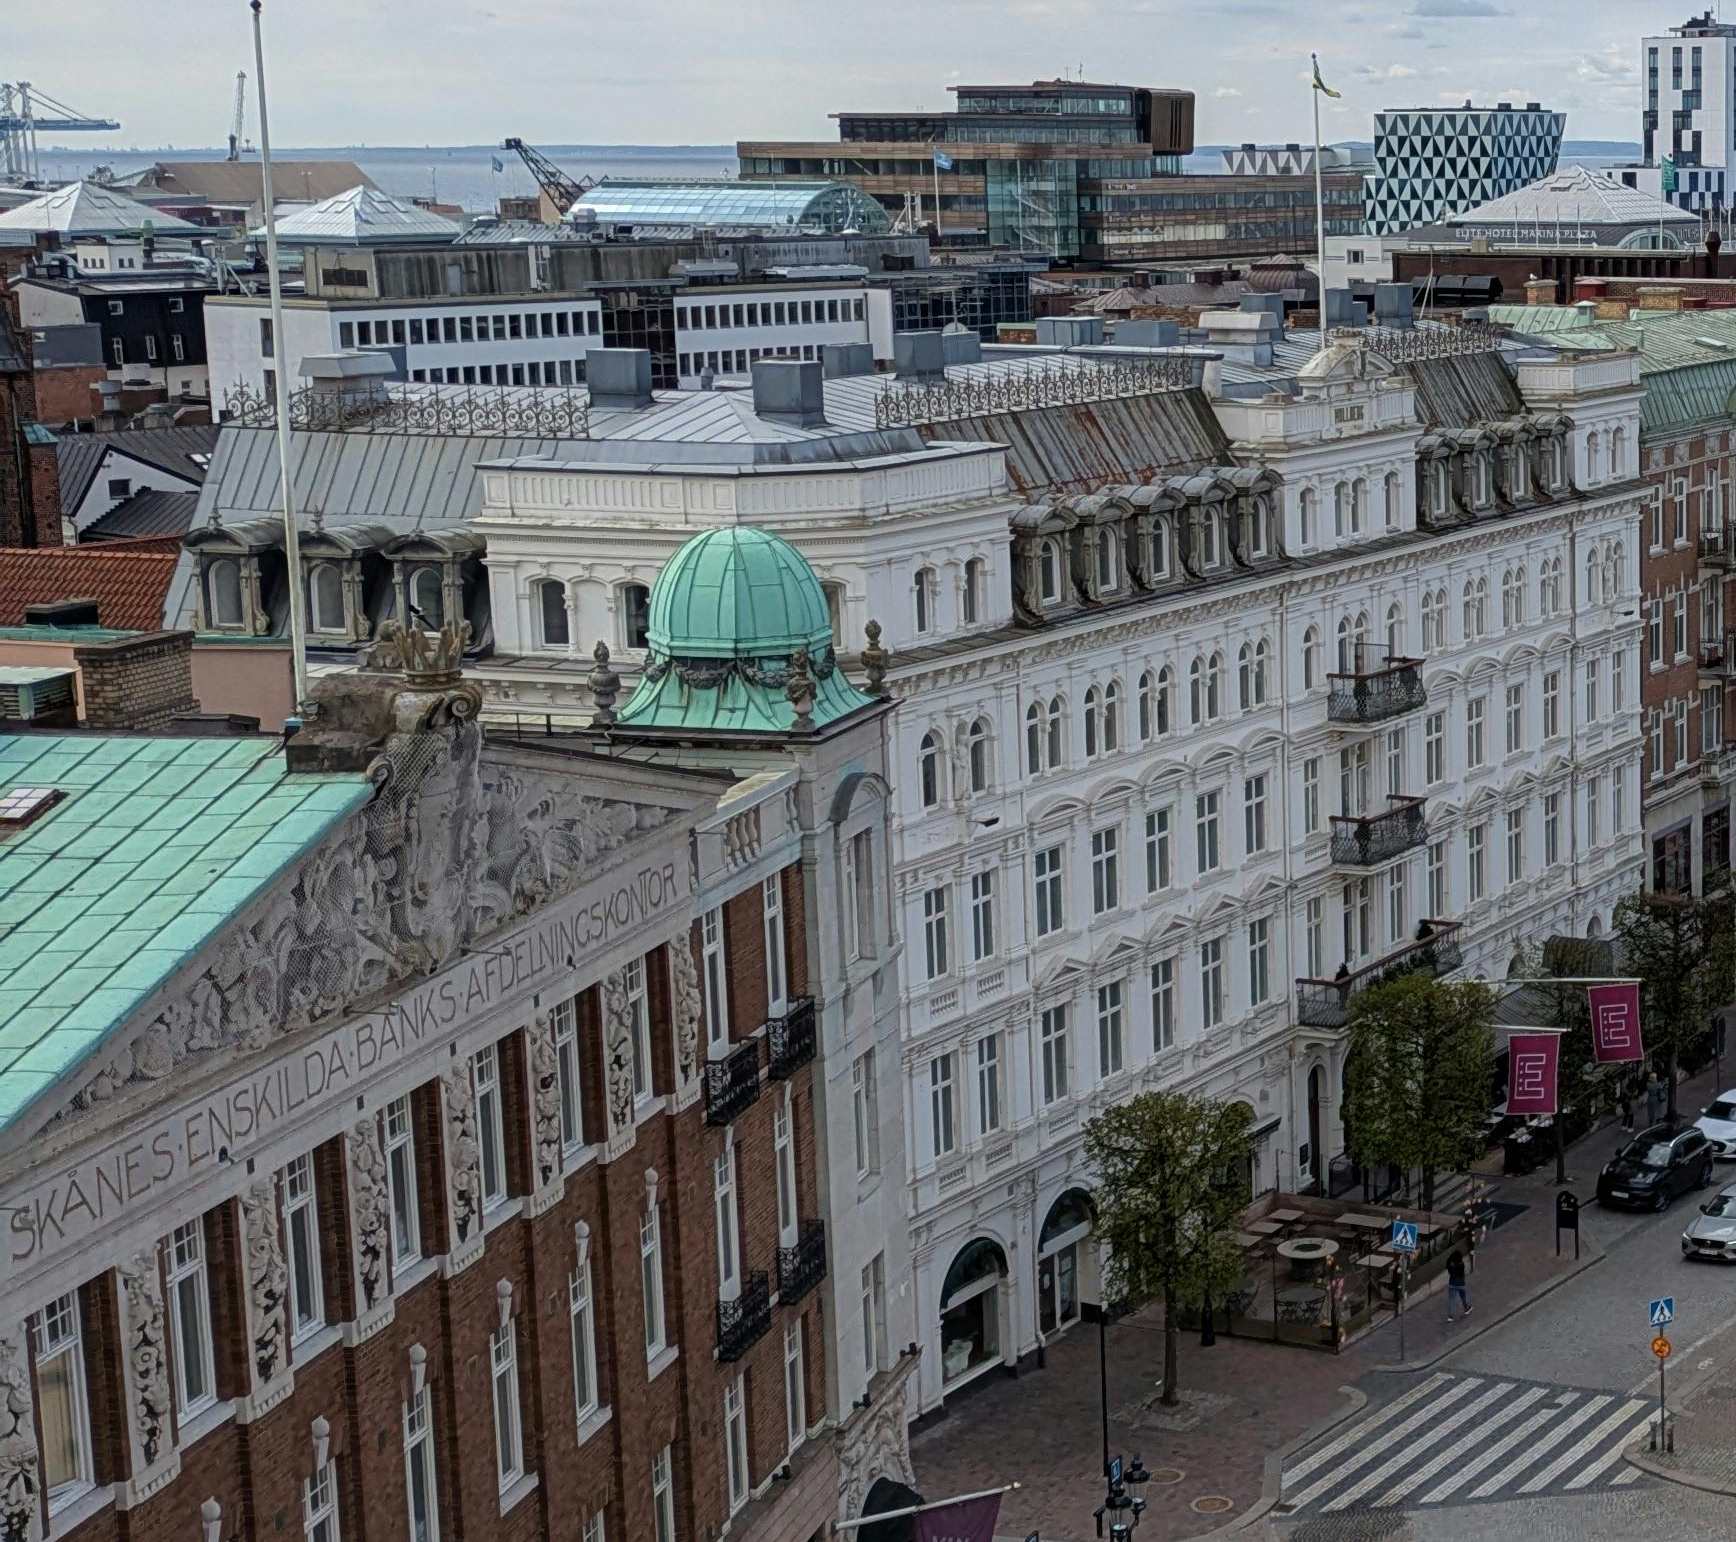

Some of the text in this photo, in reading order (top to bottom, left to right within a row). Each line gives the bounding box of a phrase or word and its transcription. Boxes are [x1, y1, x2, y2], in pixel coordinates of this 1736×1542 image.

[1455, 228, 1597, 239] ELITE HOTEL MARINA PLAZA
[10, 862, 678, 1261] SKÅNES ENSKILDA BANKS AFDELNINGSKONTOR
